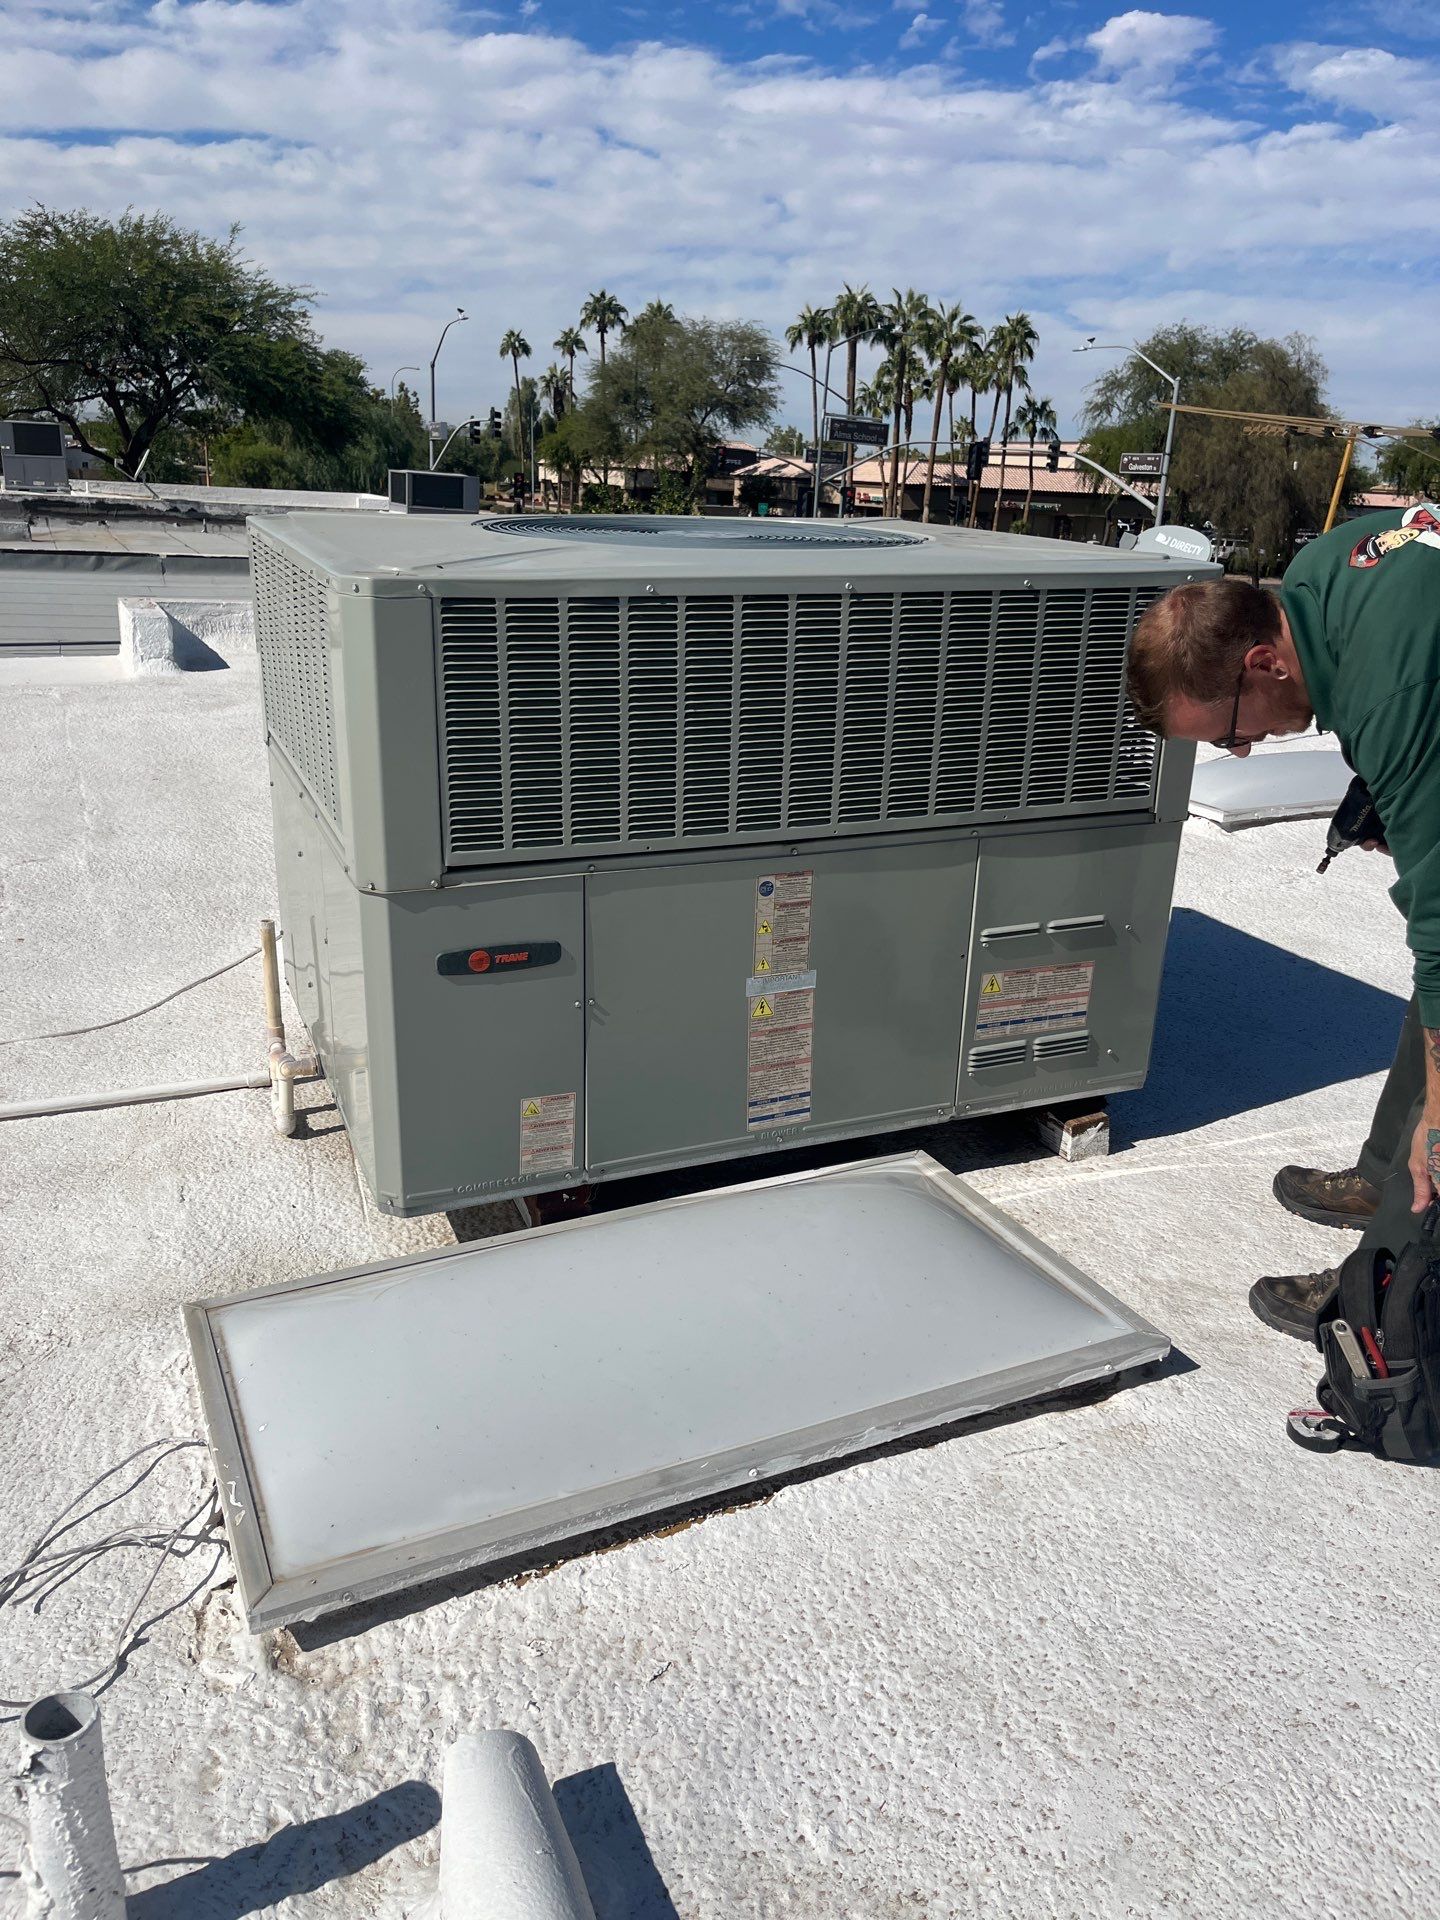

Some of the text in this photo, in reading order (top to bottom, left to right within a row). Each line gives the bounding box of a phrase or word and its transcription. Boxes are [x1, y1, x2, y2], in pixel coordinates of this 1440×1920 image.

[833, 431, 851, 439] Alma
[853, 432, 877, 442] School
[1350, 804, 1371, 832] makita
